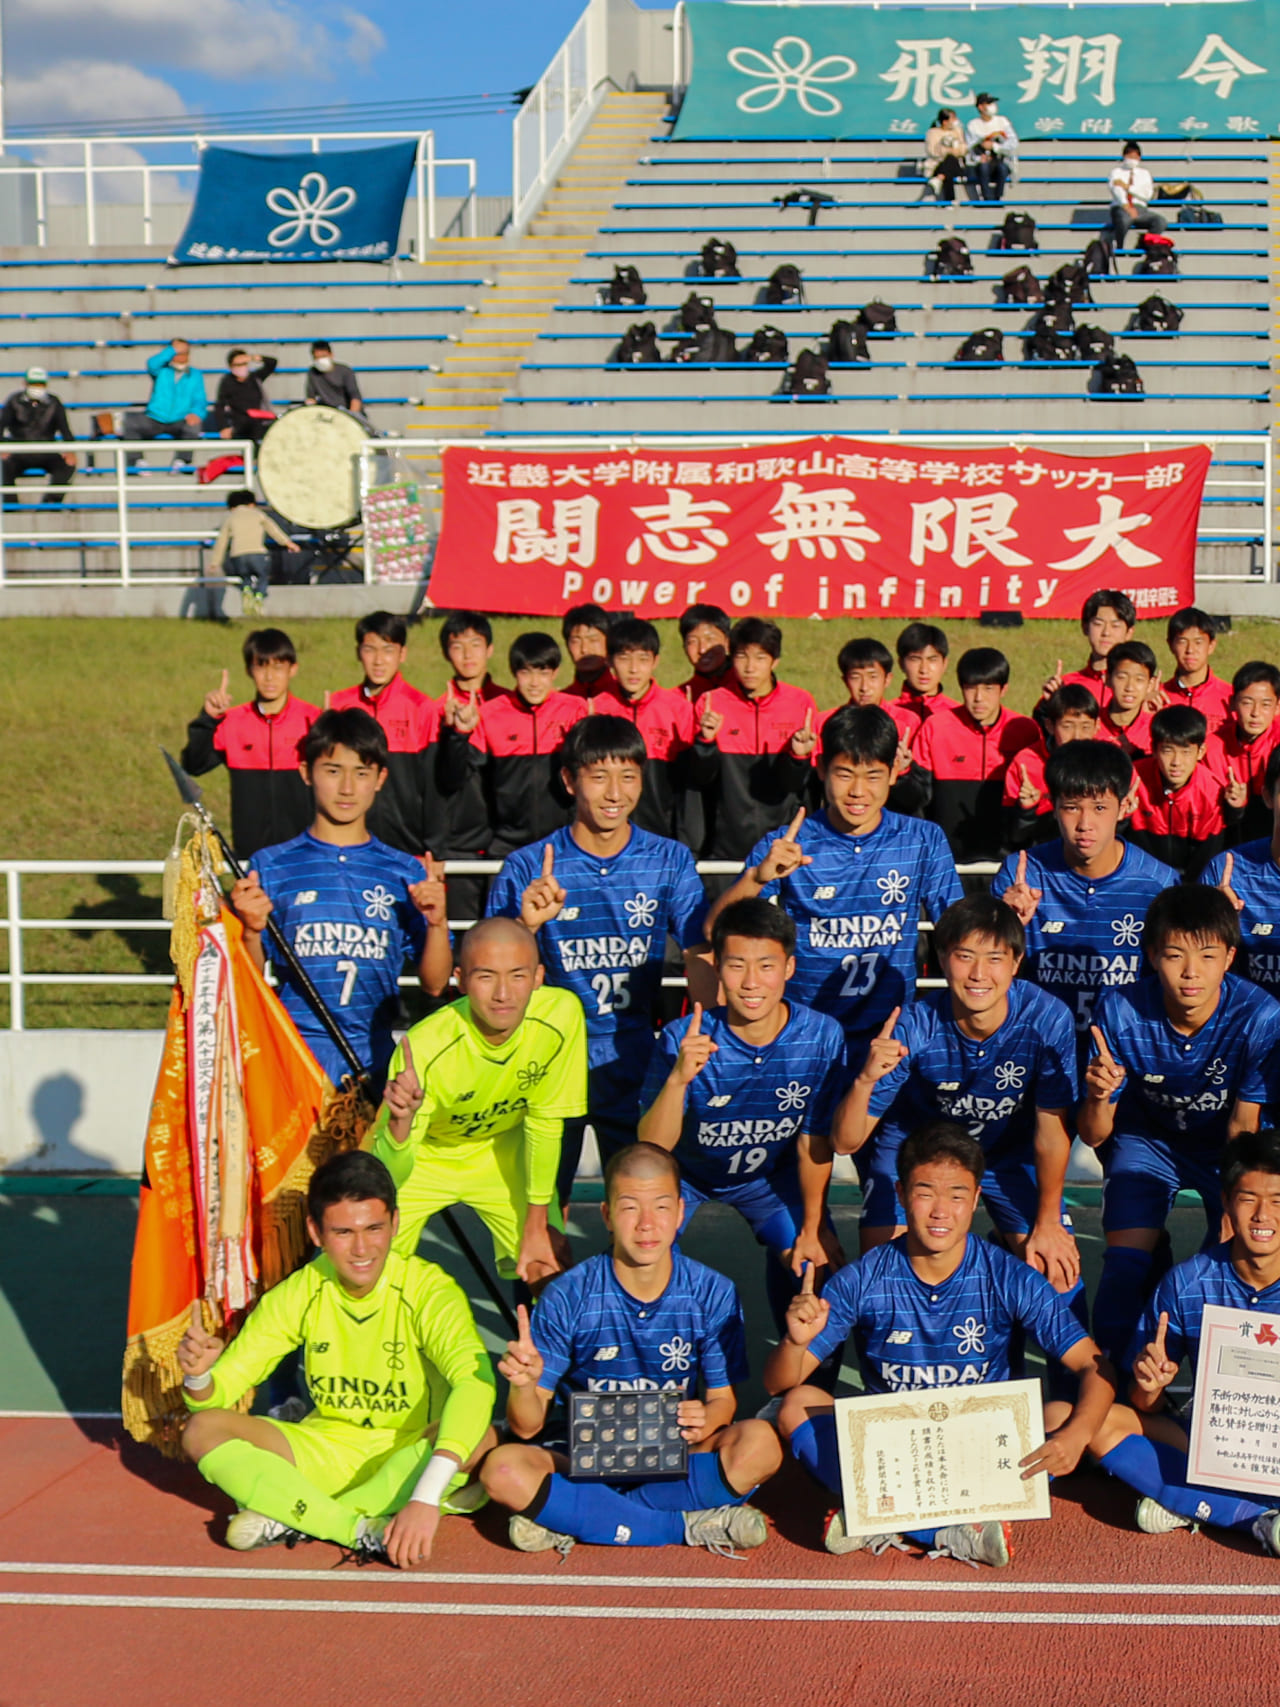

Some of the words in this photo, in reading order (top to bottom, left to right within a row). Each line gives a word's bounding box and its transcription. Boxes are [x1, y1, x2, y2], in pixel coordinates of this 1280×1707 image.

[467, 451, 1185, 491] 近畿大学附属和歌山高等学校サッカー部
[492, 483, 1166, 571] 闘志無限大
[562, 572, 706, 607] Power
[731, 573, 783, 608] of
[818, 573, 1058, 611] infinity
[295, 922, 388, 947] KINDAI
[809, 912, 908, 935] KINDAI
[558, 934, 652, 957] KINDAI
[840, 953, 880, 997] 23
[1038, 952, 1139, 973] KINDAI
[336, 960, 358, 1006] 7
[1036, 968, 1137, 986] WAKAYAMA
[591, 972, 631, 1016] 25
[1076, 991, 1095, 1031] 5
[699, 1114, 803, 1137] KINDAI
[727, 1147, 768, 1175] 19
[308, 1374, 408, 1399] KINDAI
[881, 1362, 990, 1386] KINDAI
